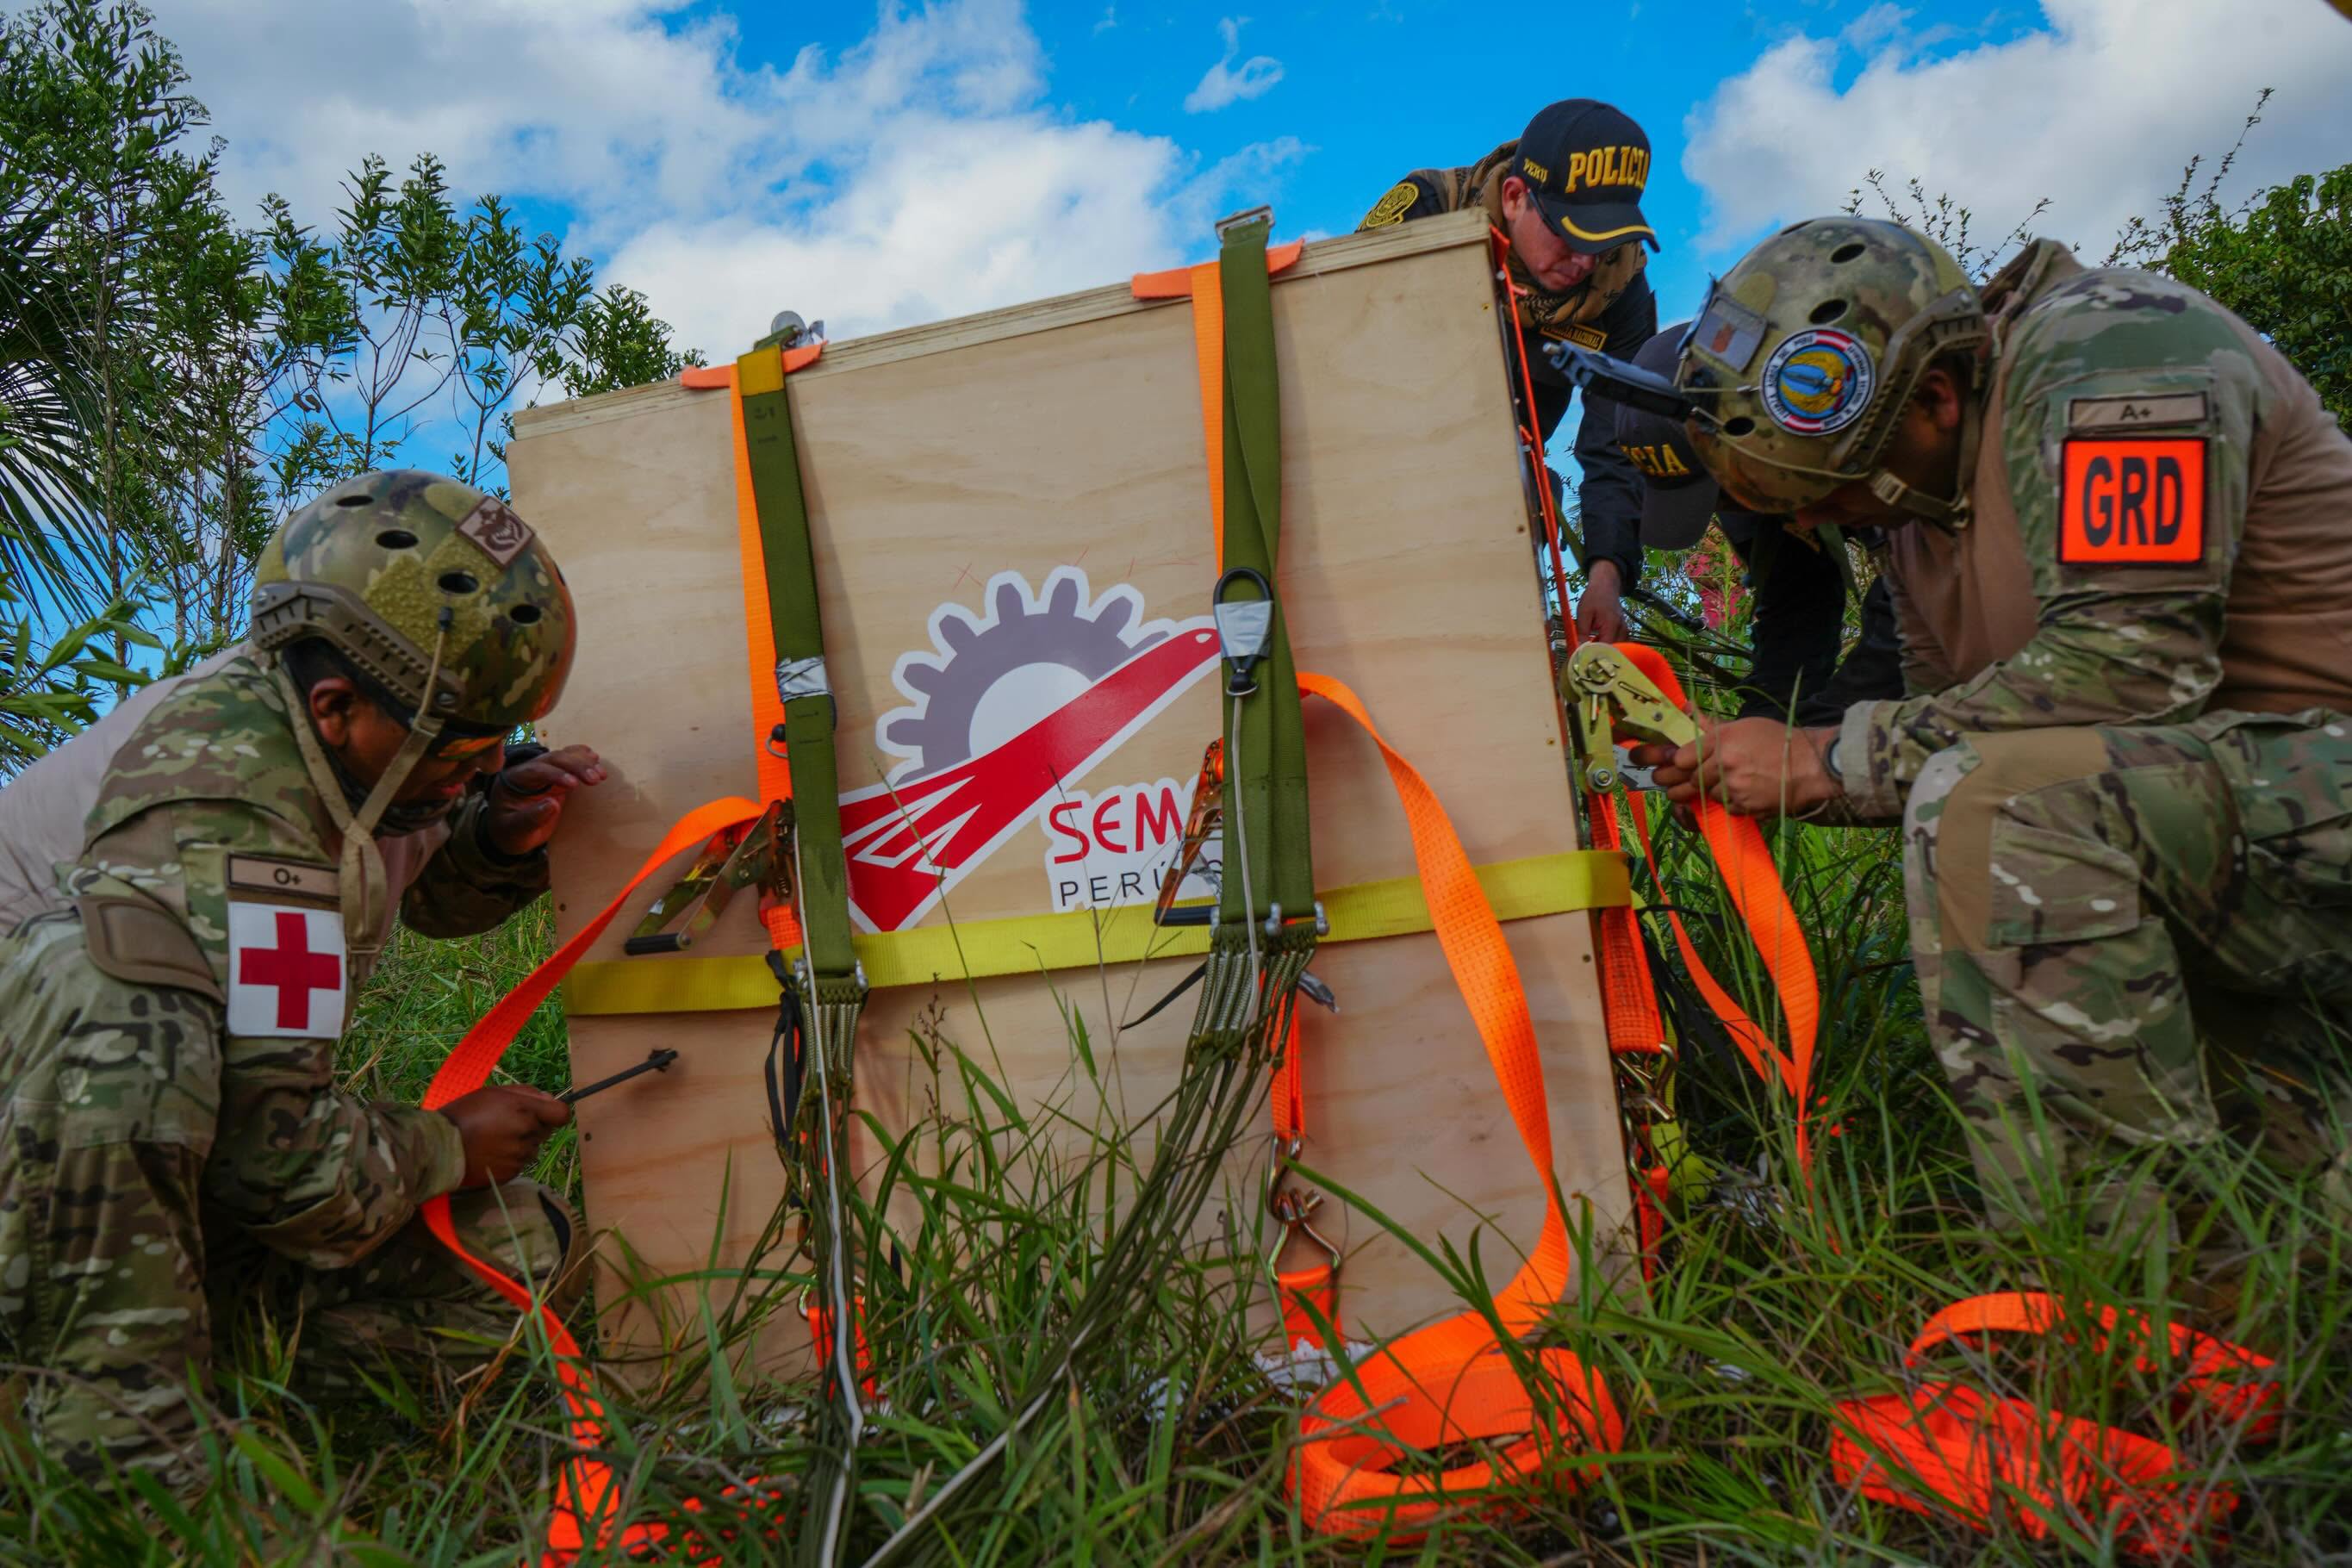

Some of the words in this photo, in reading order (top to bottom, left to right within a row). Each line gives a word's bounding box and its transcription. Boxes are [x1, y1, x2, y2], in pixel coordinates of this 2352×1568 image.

[2119, 403, 2152, 421] A+
[1621, 443, 1690, 476] CIA
[2081, 456, 2183, 547] GRD
[1048, 787, 1185, 864] SEM
